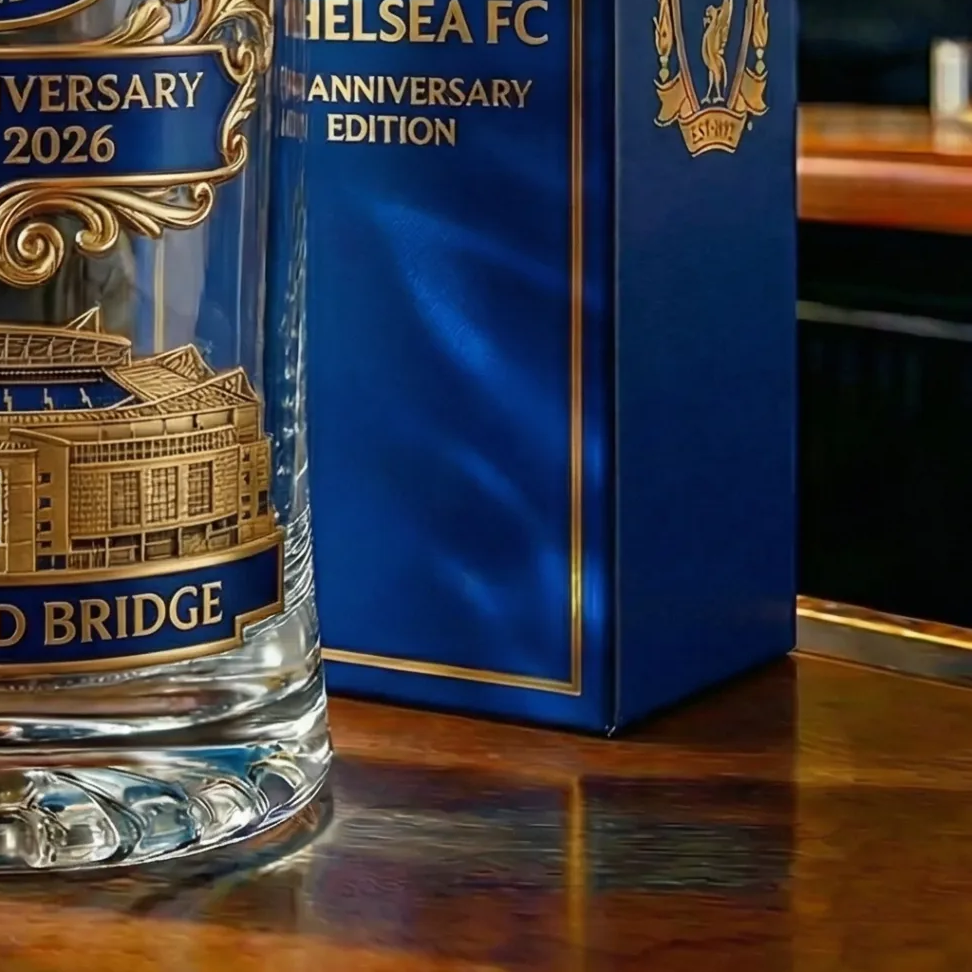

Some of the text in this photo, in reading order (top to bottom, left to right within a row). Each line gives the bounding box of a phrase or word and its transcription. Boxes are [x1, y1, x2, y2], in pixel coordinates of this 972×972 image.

[486, 0, 550, 46] FC
[307, 74, 533, 109] ANNIVERSARY
[2, 123, 117, 164] 2026
[327, 112, 457, 148] EDITION
[43, 581, 224, 646] BRIDGE
